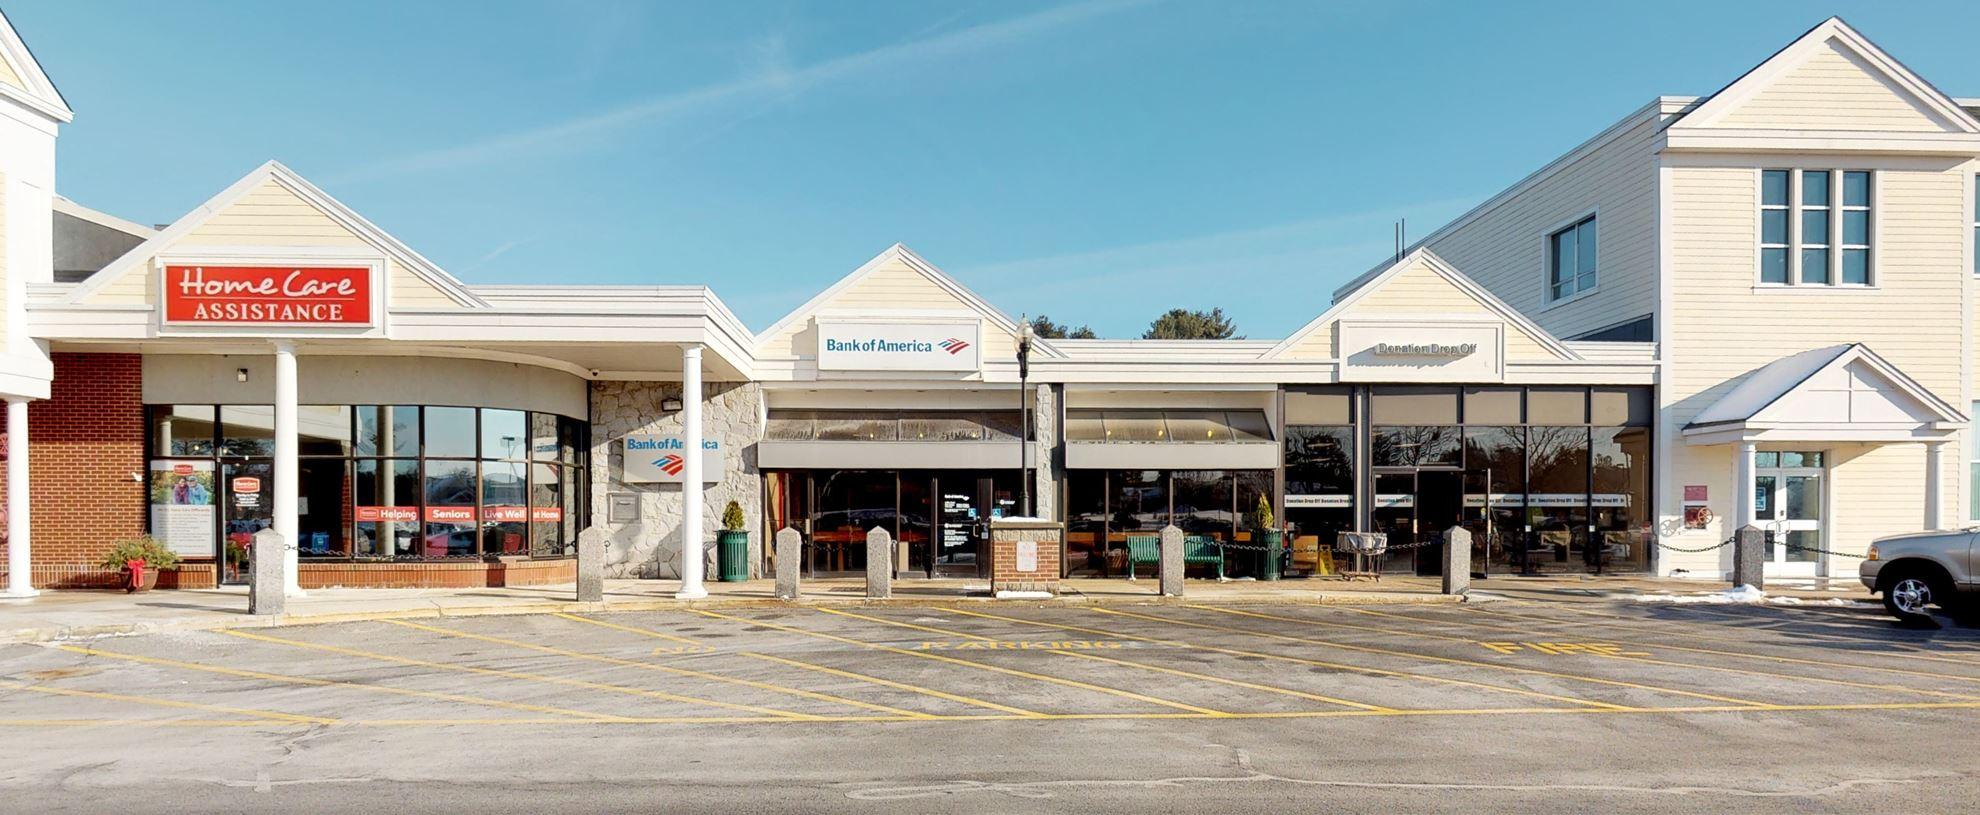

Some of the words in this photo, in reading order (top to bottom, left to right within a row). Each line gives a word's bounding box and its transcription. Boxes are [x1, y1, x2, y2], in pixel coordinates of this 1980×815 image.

[180, 267, 278, 295] Home
[283, 270, 356, 296] Care
[194, 302, 344, 321] ASSISTANCE
[826, 338, 861, 351] Bank
[862, 338, 876, 351] of
[877, 339, 933, 352] America
[1378, 343, 1429, 353] Donation
[1431, 343, 1458, 355] Drop
[1460, 343, 1477, 354] Off
[627, 438, 657, 450] Bank
[657, 438, 669, 450] of
[381, 509, 417, 520] Helping
[432, 509, 471, 518] Seniors
[484, 510, 503, 518] Live
[505, 510, 525, 518] Well
[919, 640, 1122, 649] PARKING
